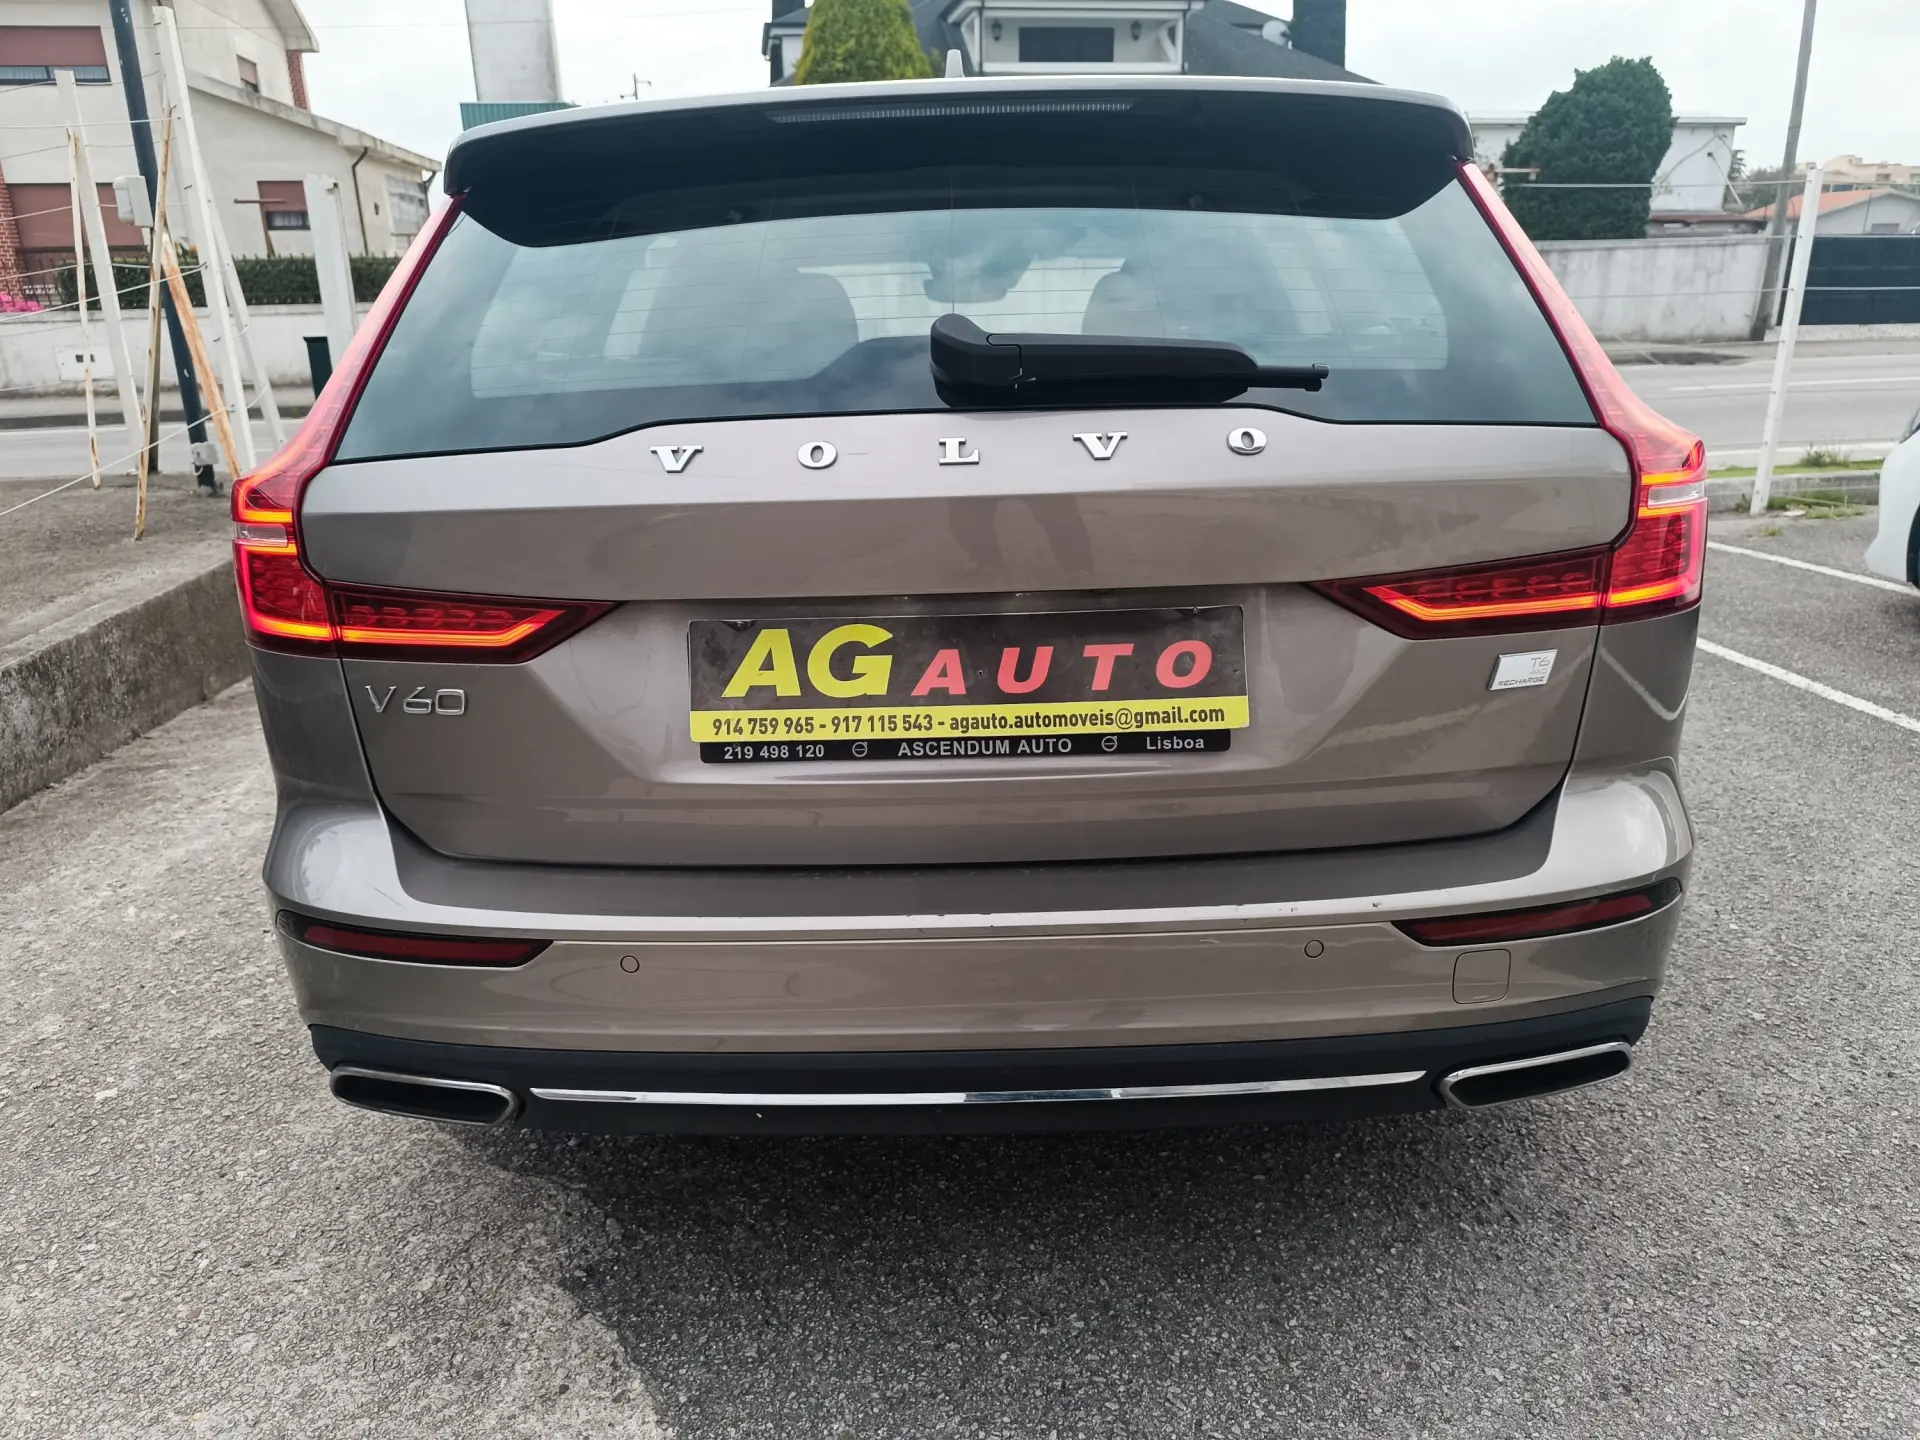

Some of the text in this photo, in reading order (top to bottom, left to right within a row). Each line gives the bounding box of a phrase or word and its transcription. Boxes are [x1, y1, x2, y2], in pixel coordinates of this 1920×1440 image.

[650, 427, 1268, 473] VOLVO
[721, 623, 1213, 698] AG AUTO
[1531, 656, 1550, 667] T6
[1498, 676, 1545, 686] RECHARGE
[365, 685, 465, 715] V60
[712, 718, 743, 736] 914
[748, 717, 779, 735] 759
[783, 716, 815, 734] 965
[831, 715, 862, 733] 917
[867, 714, 898, 732] 115
[902, 713, 933, 731] 543
[949, 706, 1225, 733] agauto.automoveis@gmail.com
[724, 735, 1205, 760] 219 498 120 ASCENDUM AUTO Lisboa
